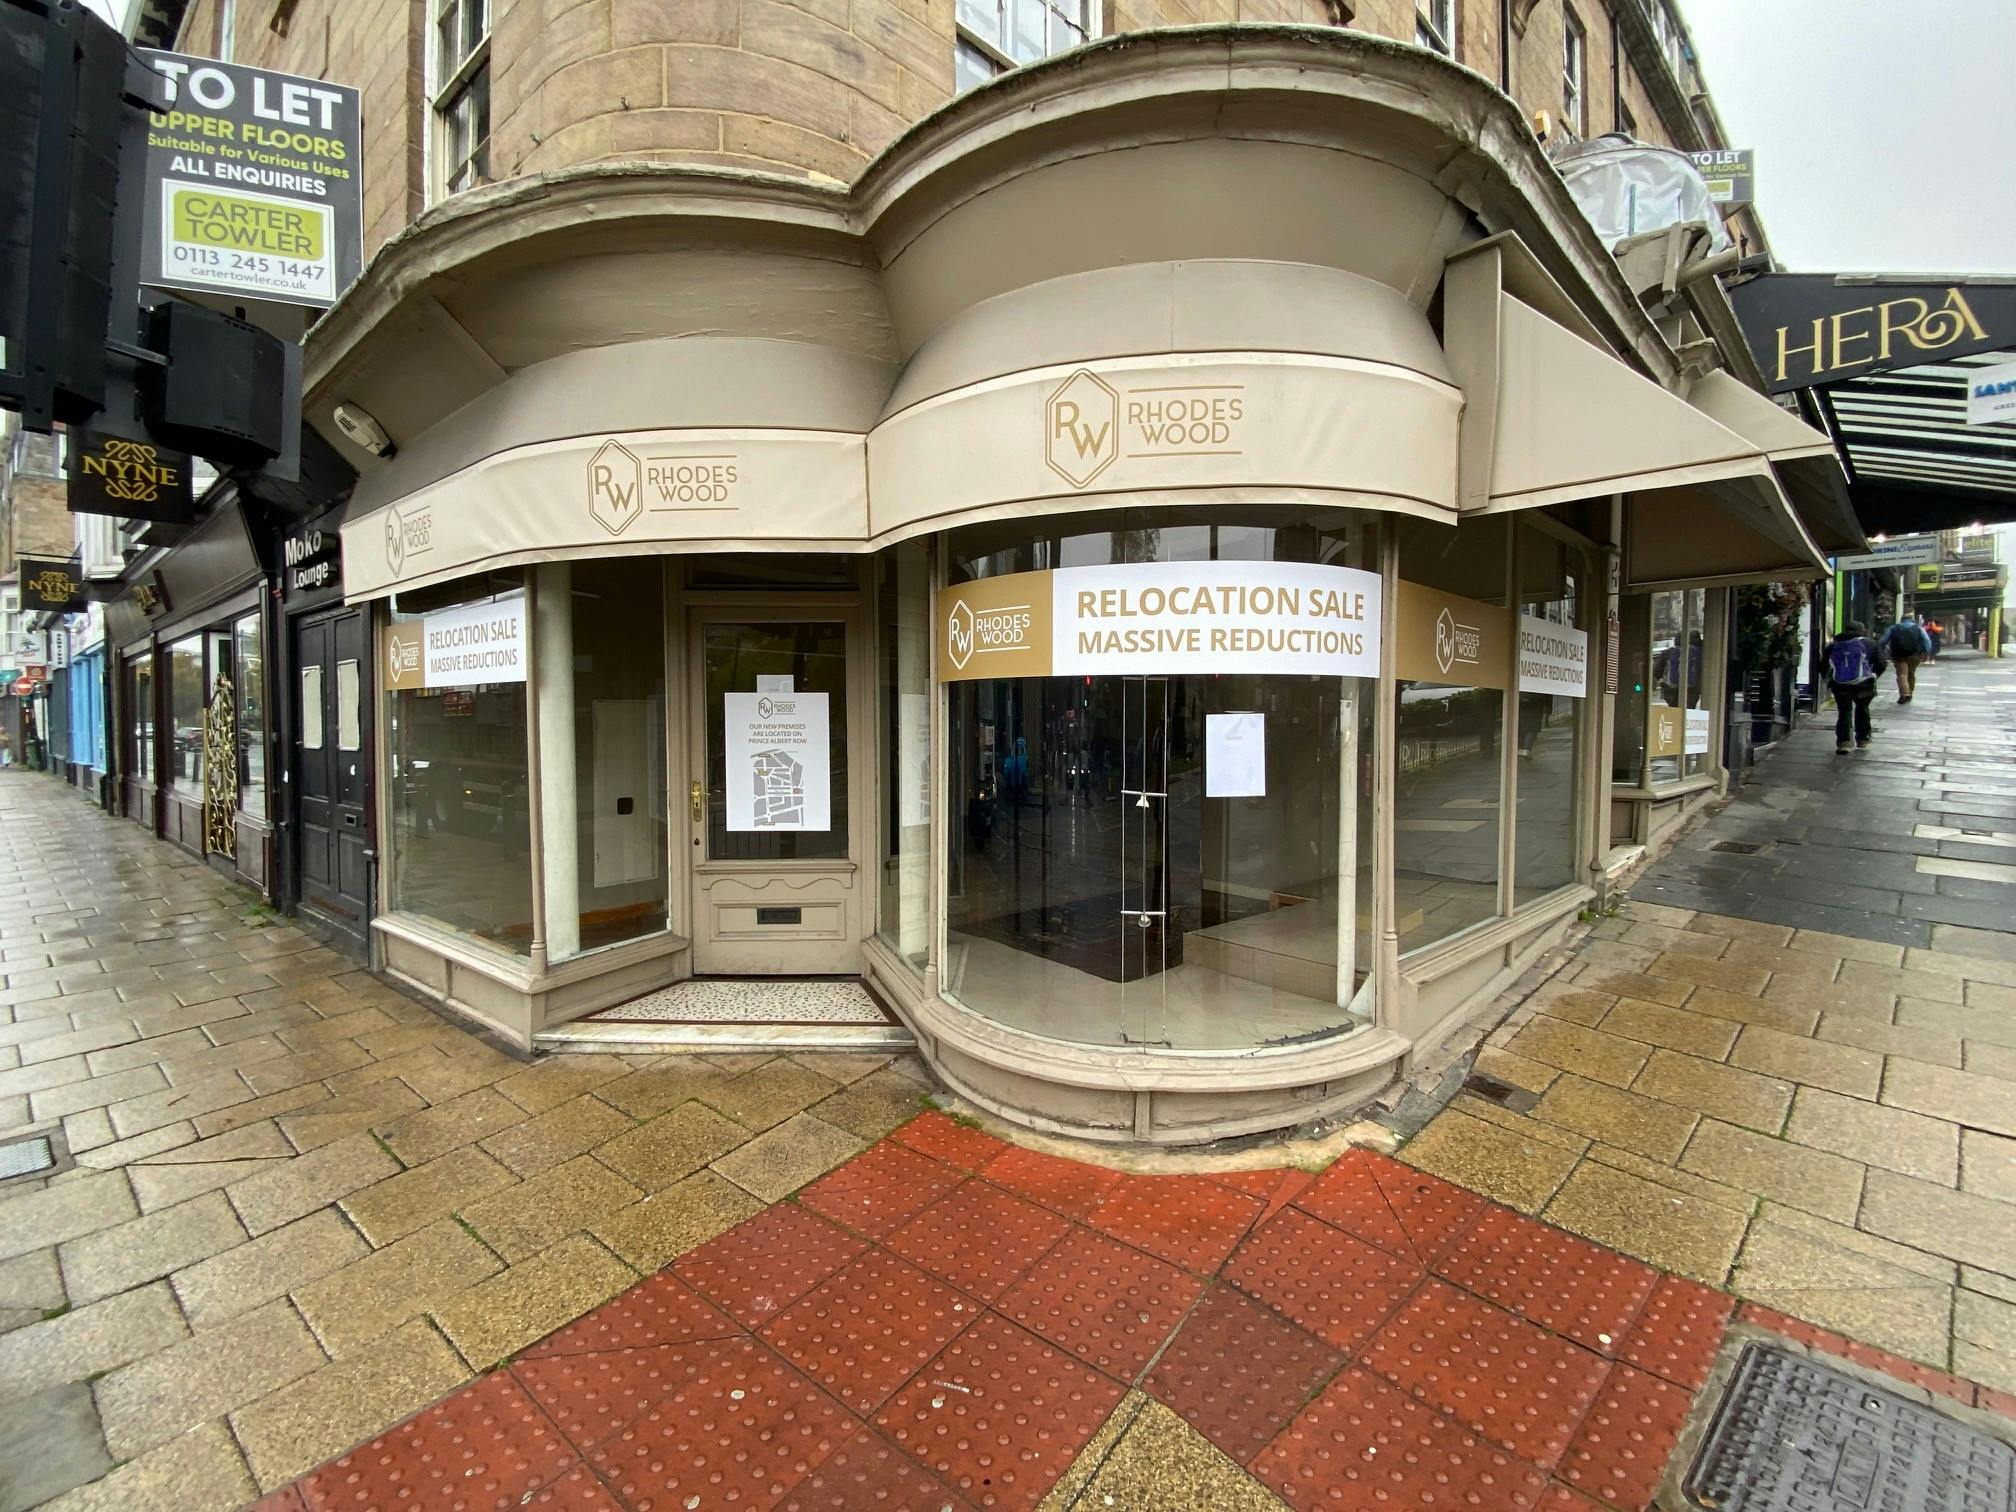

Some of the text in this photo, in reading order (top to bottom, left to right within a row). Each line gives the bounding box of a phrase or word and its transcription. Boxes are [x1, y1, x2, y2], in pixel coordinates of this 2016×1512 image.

[154, 59, 343, 130] TO LET
[150, 110, 346, 160] UPPER FLOORS
[147, 132, 350, 180] Suitable for Various Uses
[1691, 151, 1740, 165] TO LET
[170, 156, 327, 196] ALL ENQUIRIES
[184, 197, 303, 233] CARTER
[185, 218, 313, 255] TOWLER
[174, 246, 325, 281] 0113 245 1447
[191, 267, 307, 290] cartertowler.co.uk
[1775, 287, 1990, 381] HERA
[1128, 398, 1243, 425] RHODES
[1140, 421, 1230, 445] WOOD
[82, 455, 179, 486] NYNE
[648, 465, 737, 485] RHODES
[658, 484, 728, 502] WOOD
[403, 514, 431, 534] RHODES
[285, 530, 321, 567] Moko
[407, 531, 429, 549] WOOD
[28, 578, 80, 594] NYNE
[293, 561, 328, 590] Lounge
[1078, 586, 1364, 620] RELOCATION SALE
[430, 618, 517, 650] RELOCATION SALE
[976, 614, 1031, 633] RHODES
[981, 629, 1024, 645] WOOD
[1078, 628, 1363, 656] MASSIVE REDUCTIONS
[1455, 630, 1480, 647] RHODES
[1457, 643, 1477, 658] WOOD
[1521, 631, 1584, 663] RELOCATION SALE
[430, 648, 518, 674] MASSIVE REDUCTIONS
[1520, 660, 1583, 684] MASSIVE REDUCTIONS
